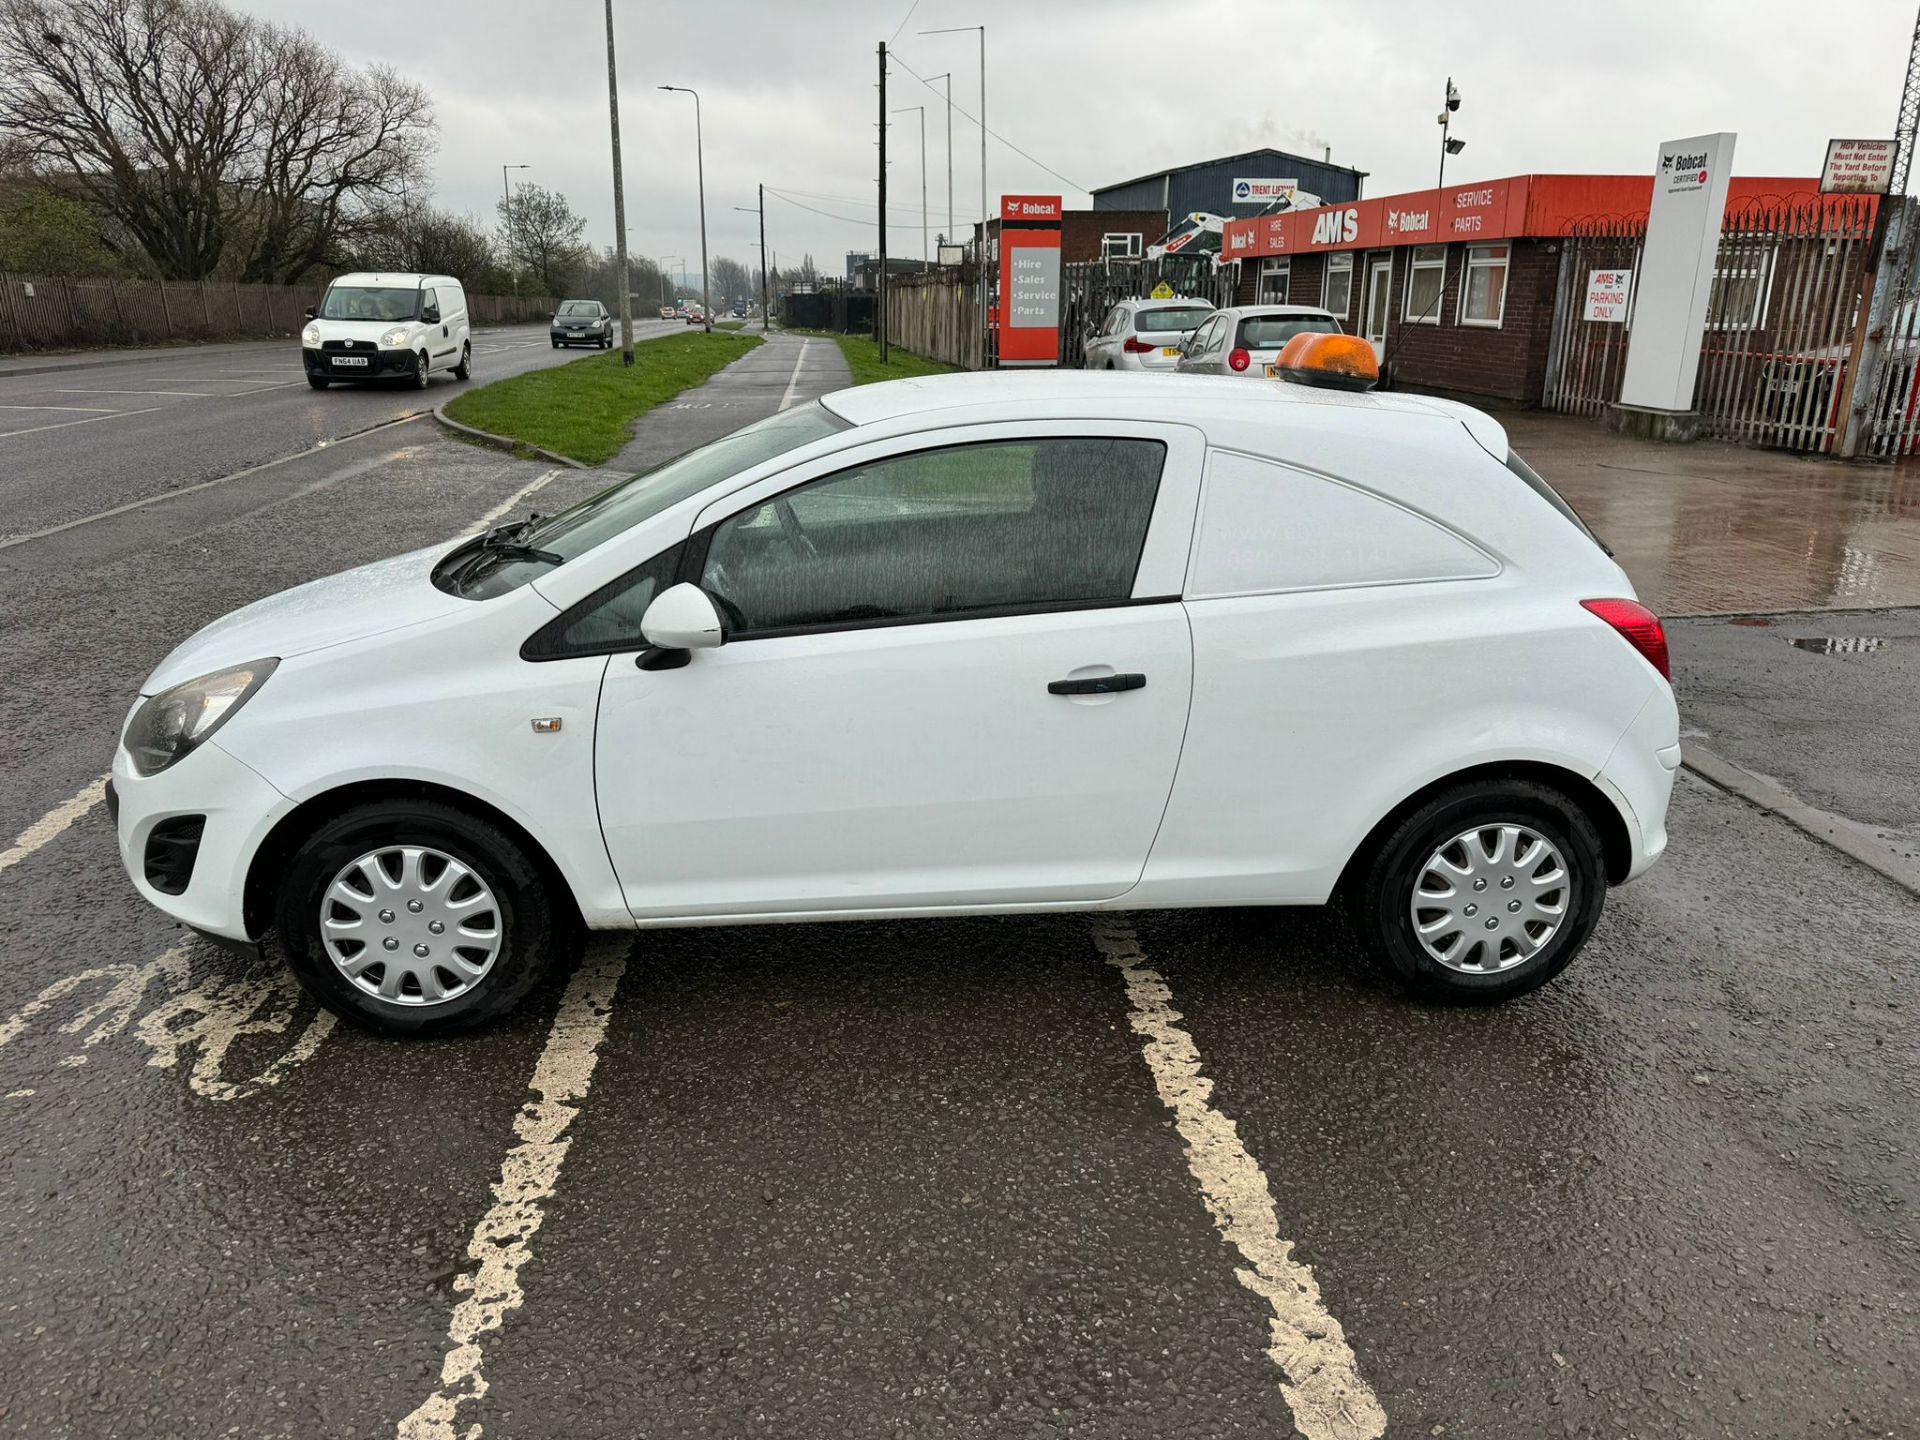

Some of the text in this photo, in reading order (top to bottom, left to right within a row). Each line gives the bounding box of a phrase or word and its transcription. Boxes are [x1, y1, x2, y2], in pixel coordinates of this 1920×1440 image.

[1840, 142, 1887, 150] HGV Vehicles
[1675, 152, 1707, 171] Bobcat
[1833, 152, 1888, 161] Must Not Enter
[1829, 162, 1887, 172] The Yard Before
[1832, 173, 1878, 183] Reporting To
[1251, 185, 1271, 195] TRENT
[1456, 189, 1493, 208] SERVICE
[1022, 203, 1055, 215] Bobcat
[1311, 208, 1358, 245] AMS
[1400, 209, 1429, 232] Bobcat
[1454, 216, 1482, 232] PARTS
[1269, 236, 1285, 248] SALES
[1018, 259, 1042, 269] Hire
[1017, 275, 1046, 284] Sales
[1594, 273, 1615, 285] AMS
[1017, 290, 1057, 300] Service
[1590, 292, 1624, 304] PARKING
[1017, 306, 1045, 315] Parts
[1593, 306, 1614, 318] ONLY
